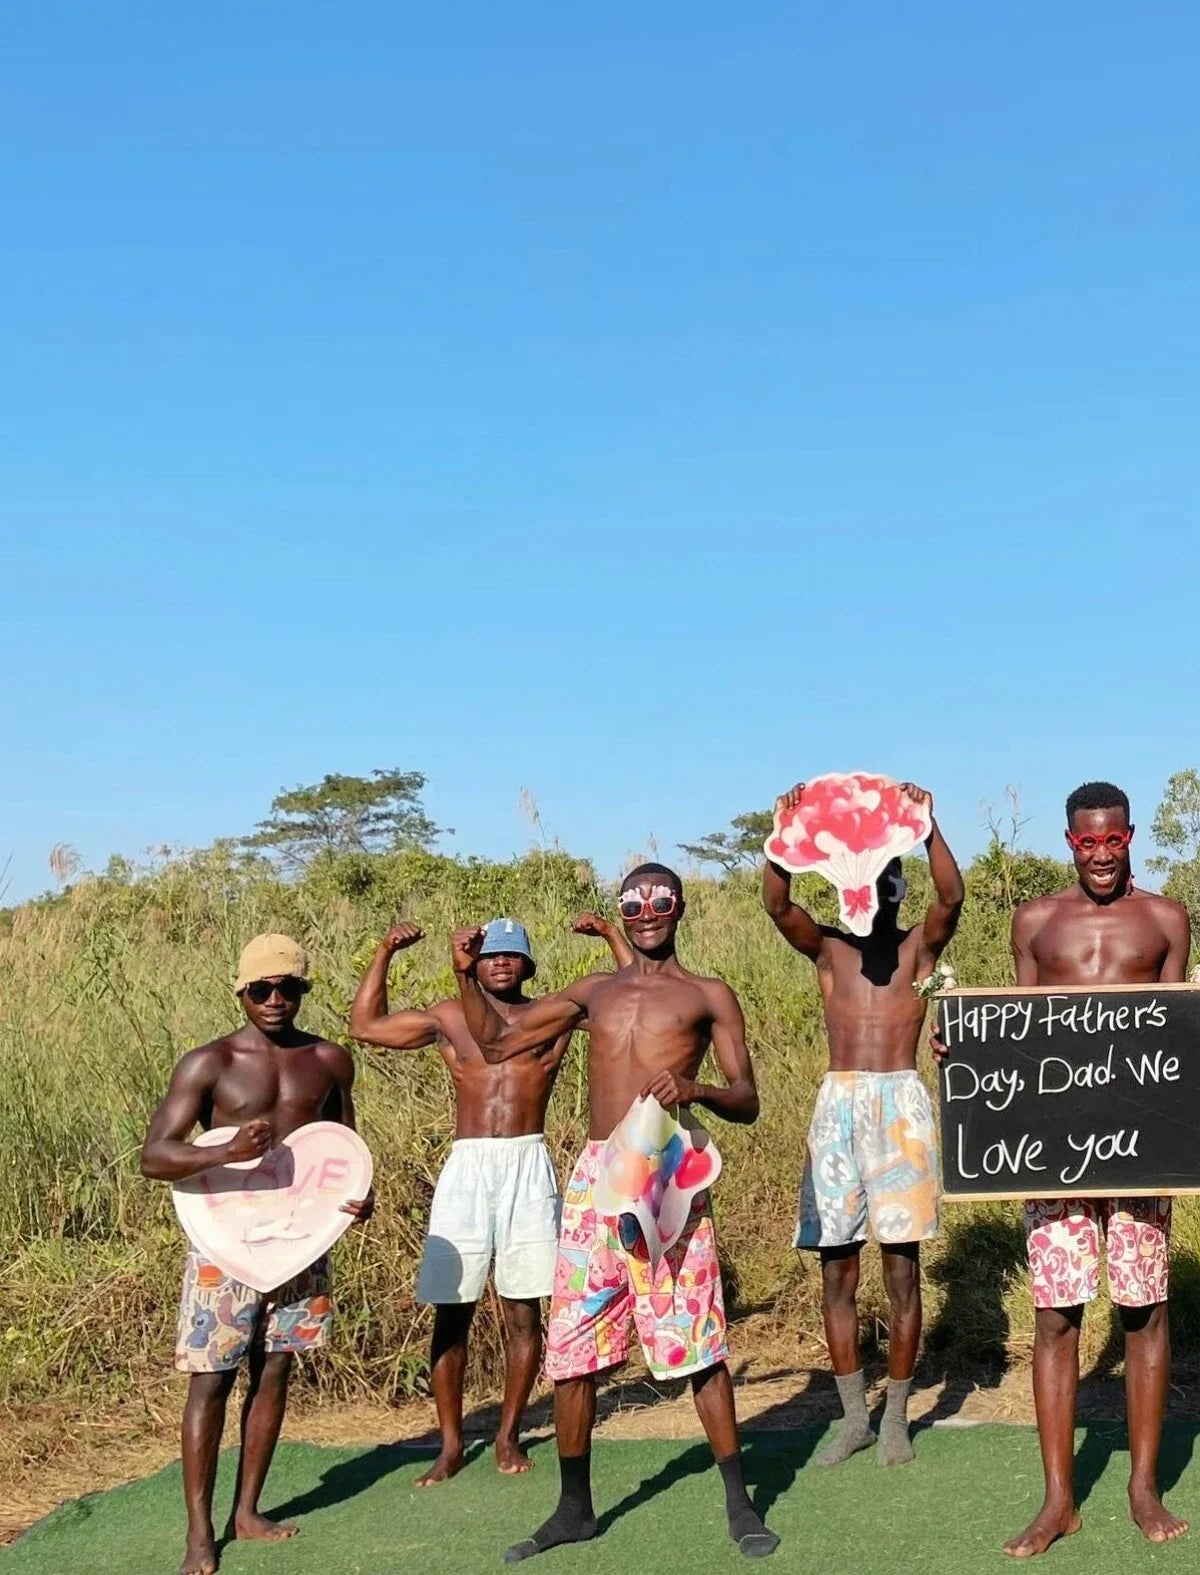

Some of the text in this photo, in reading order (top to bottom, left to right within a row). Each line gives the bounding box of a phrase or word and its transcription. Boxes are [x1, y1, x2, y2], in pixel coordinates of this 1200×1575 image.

[943, 996, 1168, 1046] Happy Father's
[944, 1044, 1180, 1111] Day, Dad. We
[958, 1123, 1139, 1184] Love you
[200, 1157, 349, 1208] LOVE
